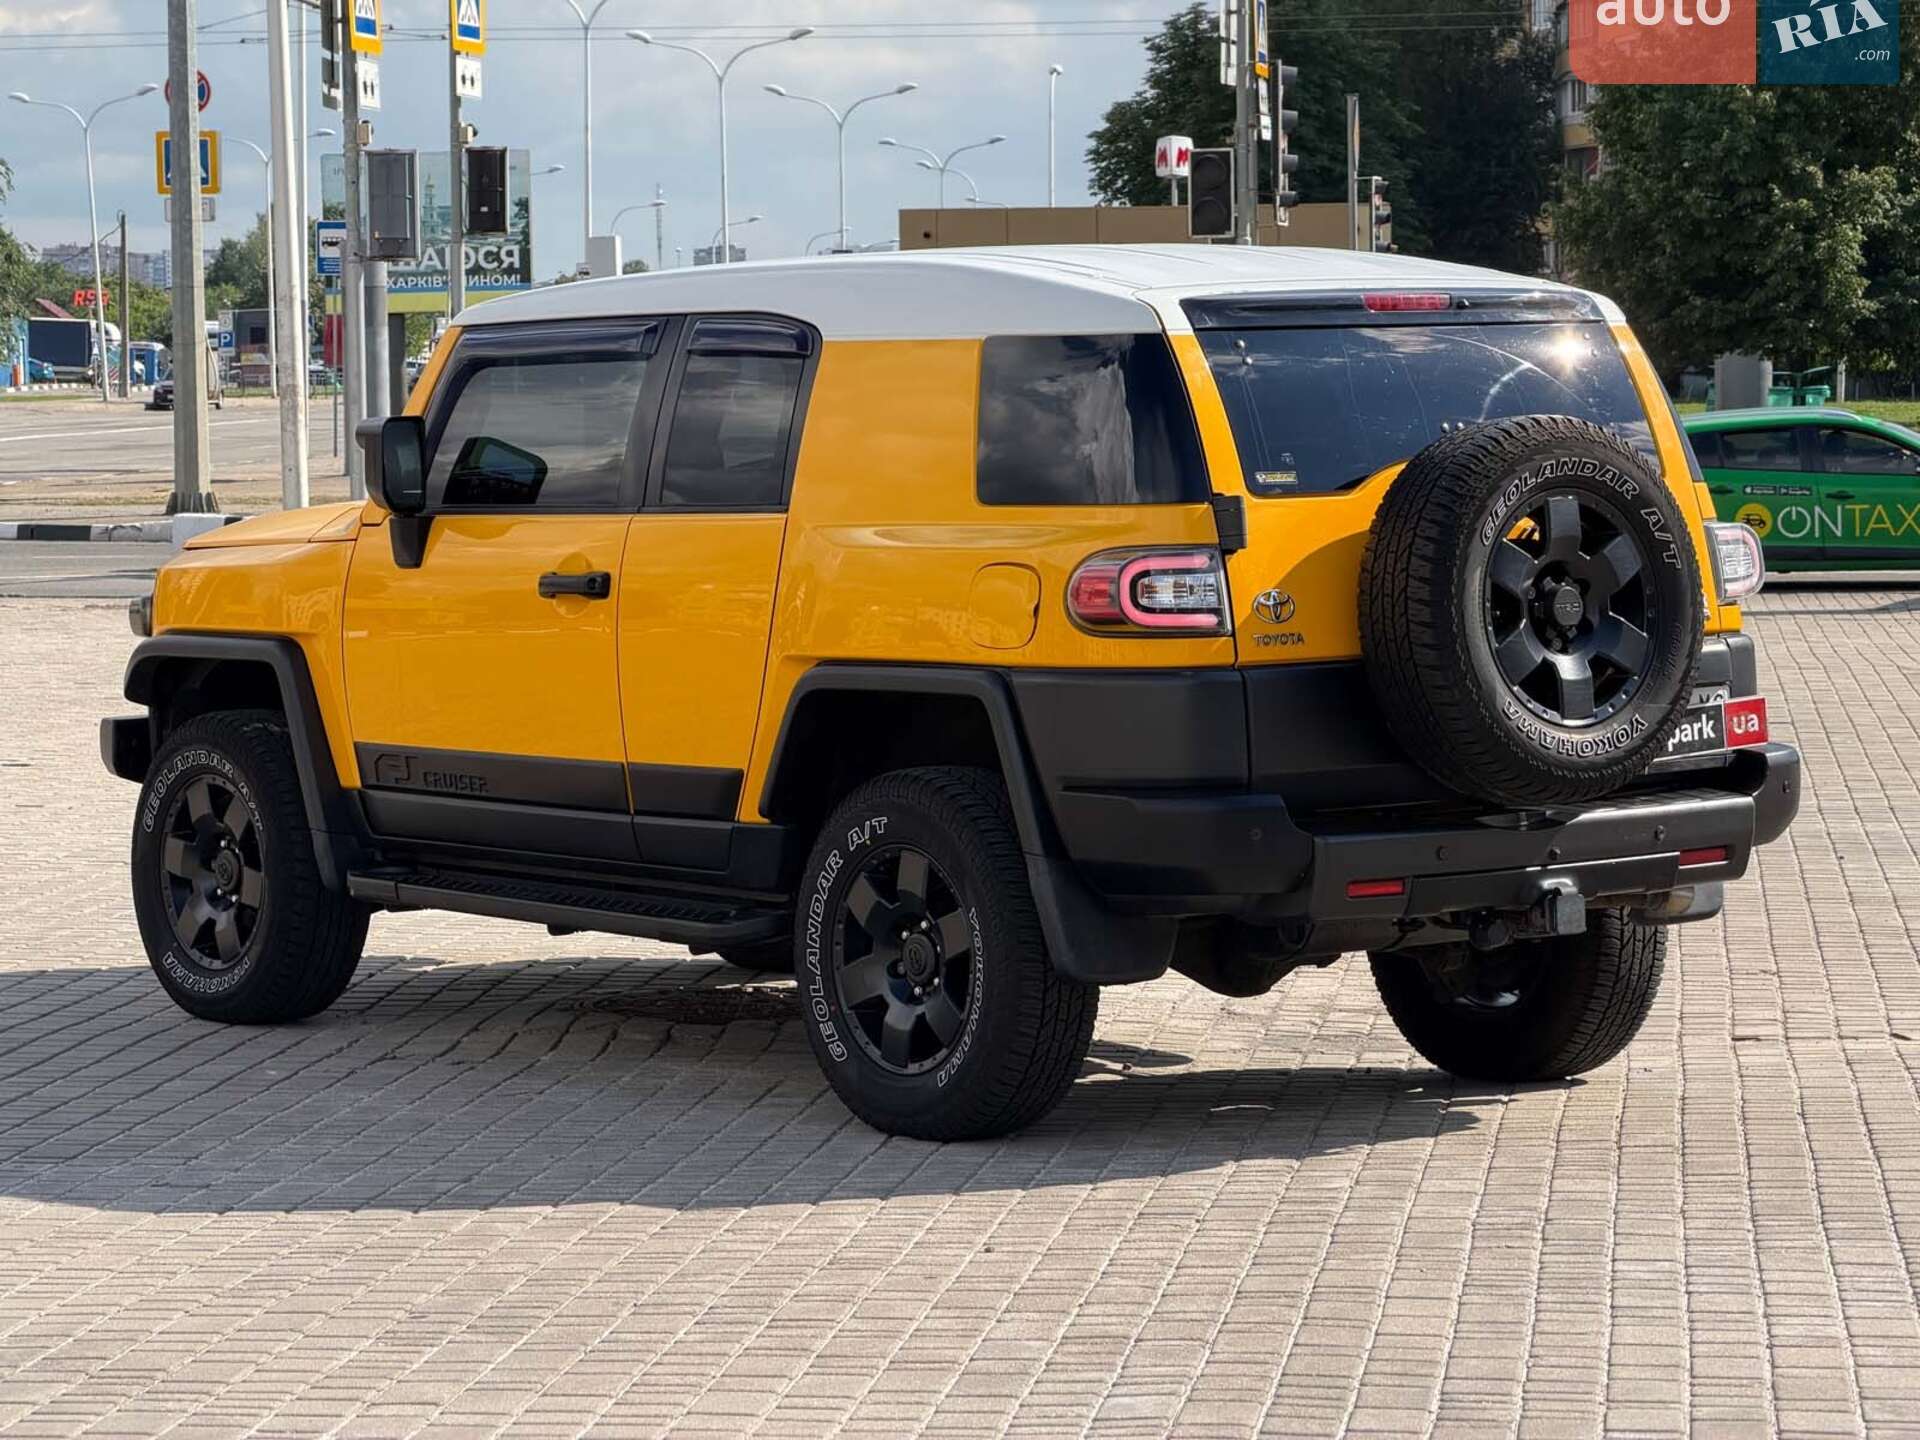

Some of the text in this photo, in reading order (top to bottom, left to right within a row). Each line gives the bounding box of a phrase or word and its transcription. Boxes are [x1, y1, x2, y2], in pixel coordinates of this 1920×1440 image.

[1481, 457, 1682, 569] GEOLANDAR A/T
[1253, 633, 1305, 646] TOYOTA
[1503, 697, 1648, 757] YOKOHAMA
[1732, 713, 1759, 735] ua
[143, 750, 234, 833] GEOLANDAR
[374, 753, 489, 793] FJ CRUISER
[806, 816, 887, 1062] GEOLANDAR A/T
[937, 907, 984, 1087] YOKOHAMA
